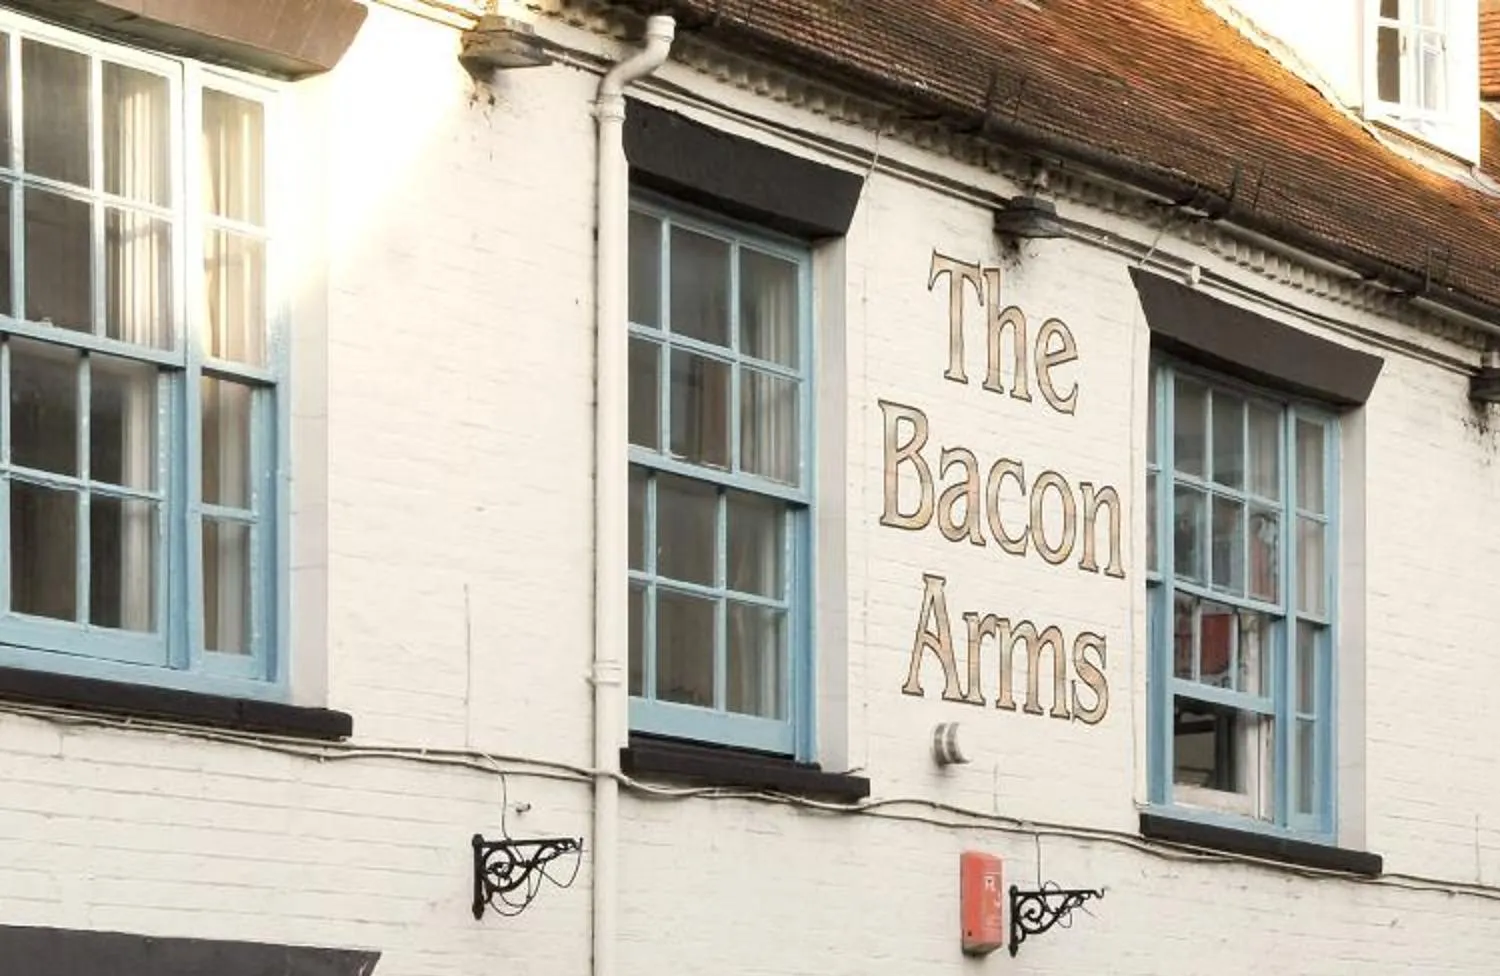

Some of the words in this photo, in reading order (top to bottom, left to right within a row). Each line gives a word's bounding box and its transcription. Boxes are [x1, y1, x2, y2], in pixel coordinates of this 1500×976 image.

[927, 247, 1079, 416] The
[877, 399, 1126, 579] Bacon
[901, 573, 1109, 725] Arms
